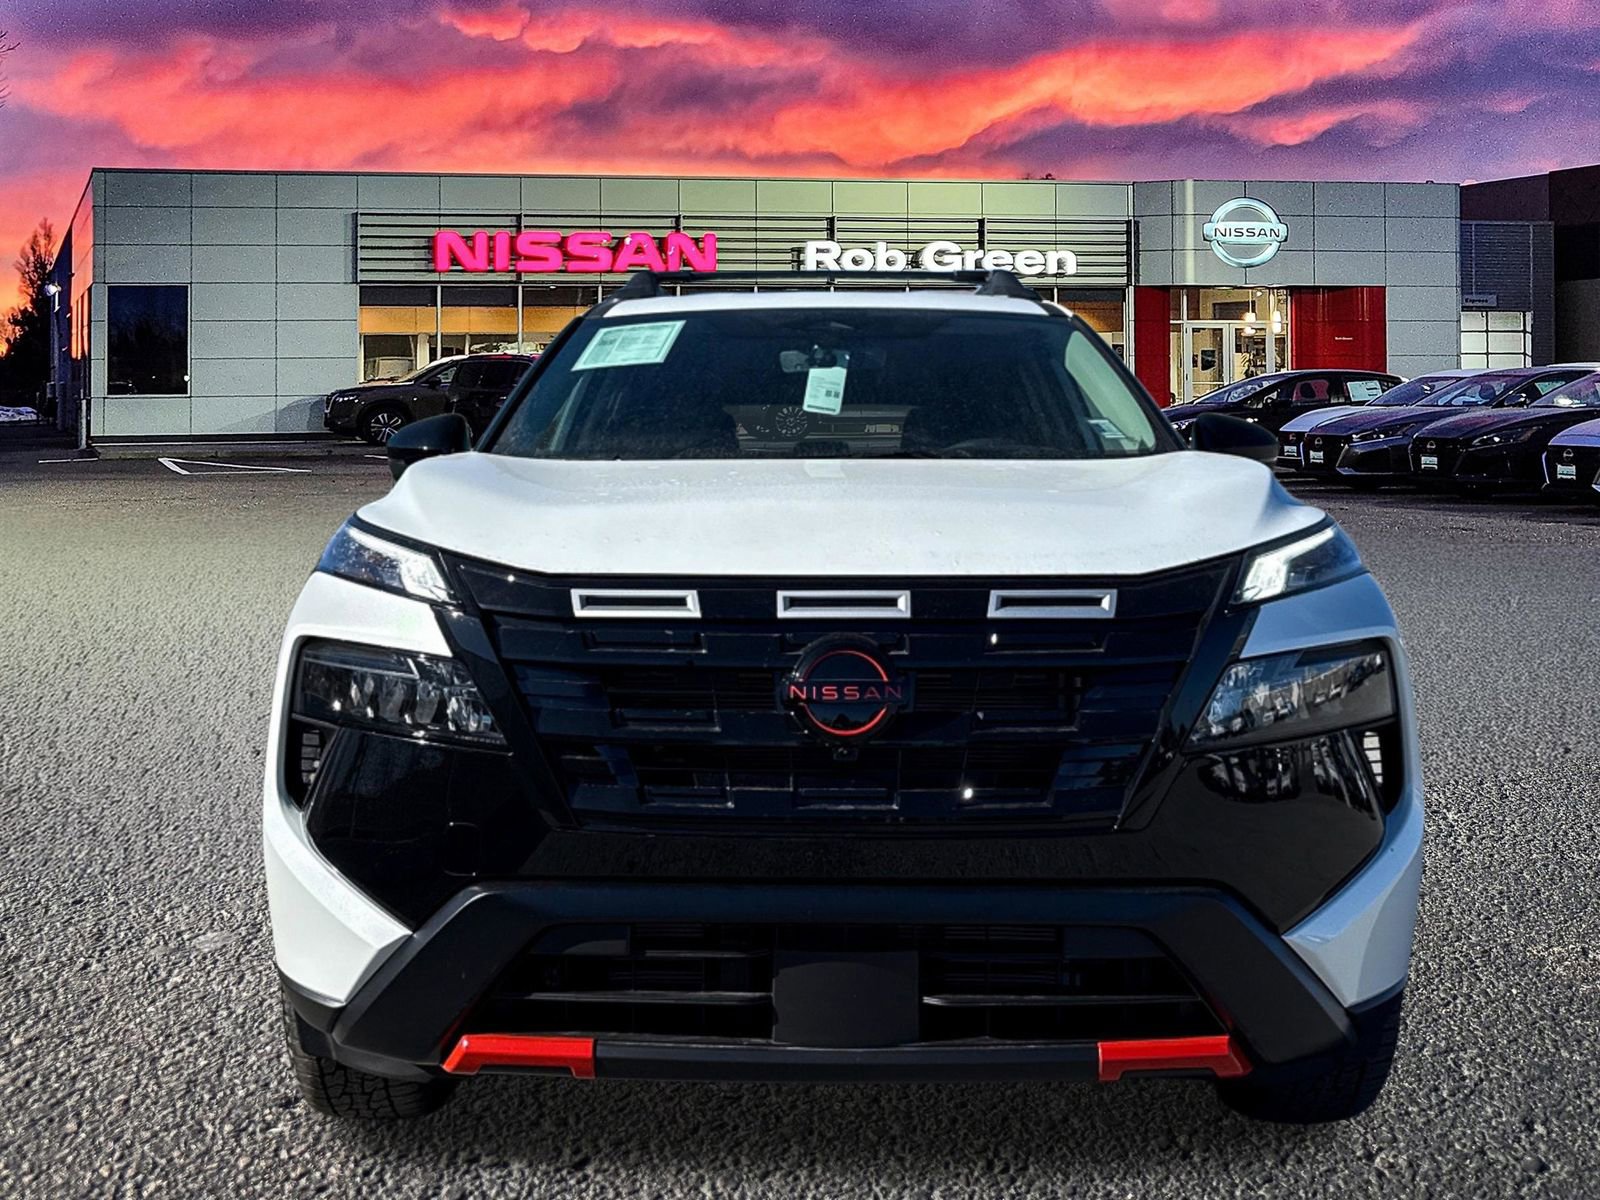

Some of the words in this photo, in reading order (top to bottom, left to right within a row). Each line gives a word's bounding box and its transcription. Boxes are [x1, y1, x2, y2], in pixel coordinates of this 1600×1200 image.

[1214, 227, 1280, 238] NISSAN
[433, 230, 718, 273] NISSAN
[804, 240, 907, 272] Rob
[921, 240, 1078, 276] Green
[789, 685, 902, 700] NISSAN
